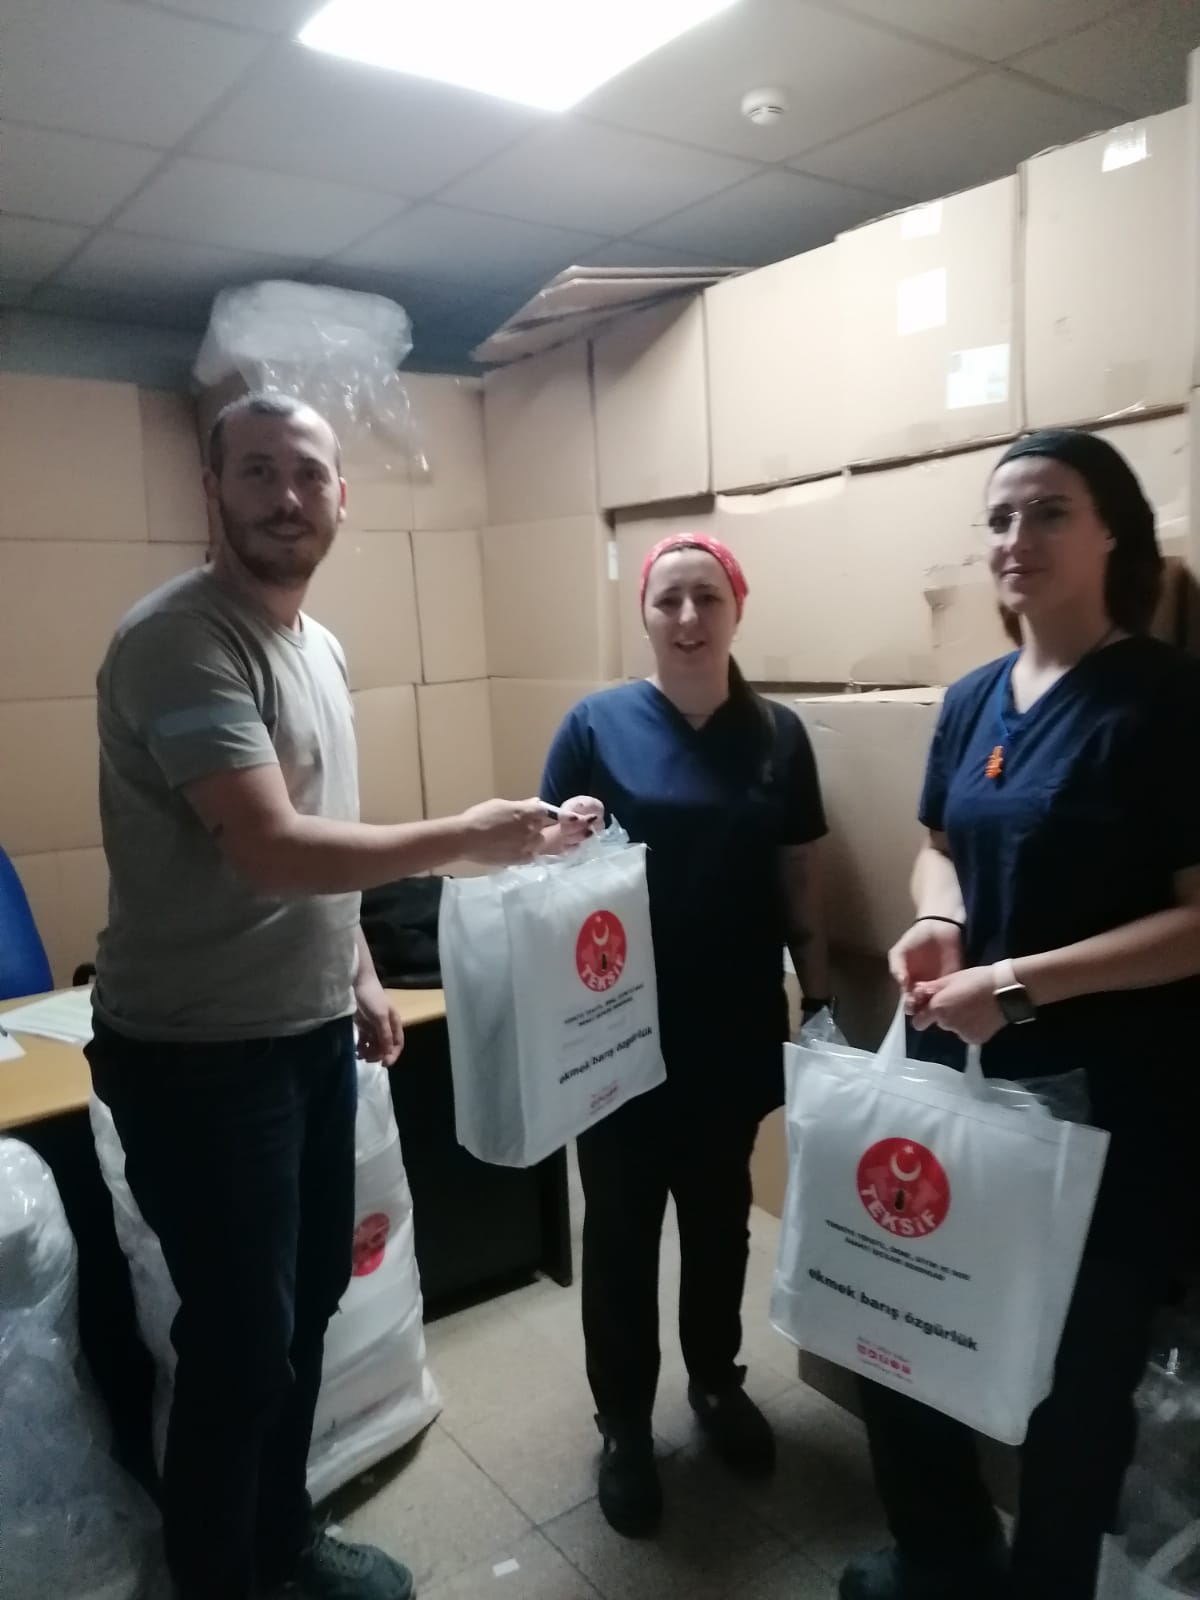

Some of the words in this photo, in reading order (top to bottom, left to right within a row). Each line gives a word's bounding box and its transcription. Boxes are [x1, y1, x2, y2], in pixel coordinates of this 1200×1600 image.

[808, 1268, 856, 1299] ekmek
[860, 1291, 899, 1320] barış
[904, 1311, 979, 1351] özgürlük
